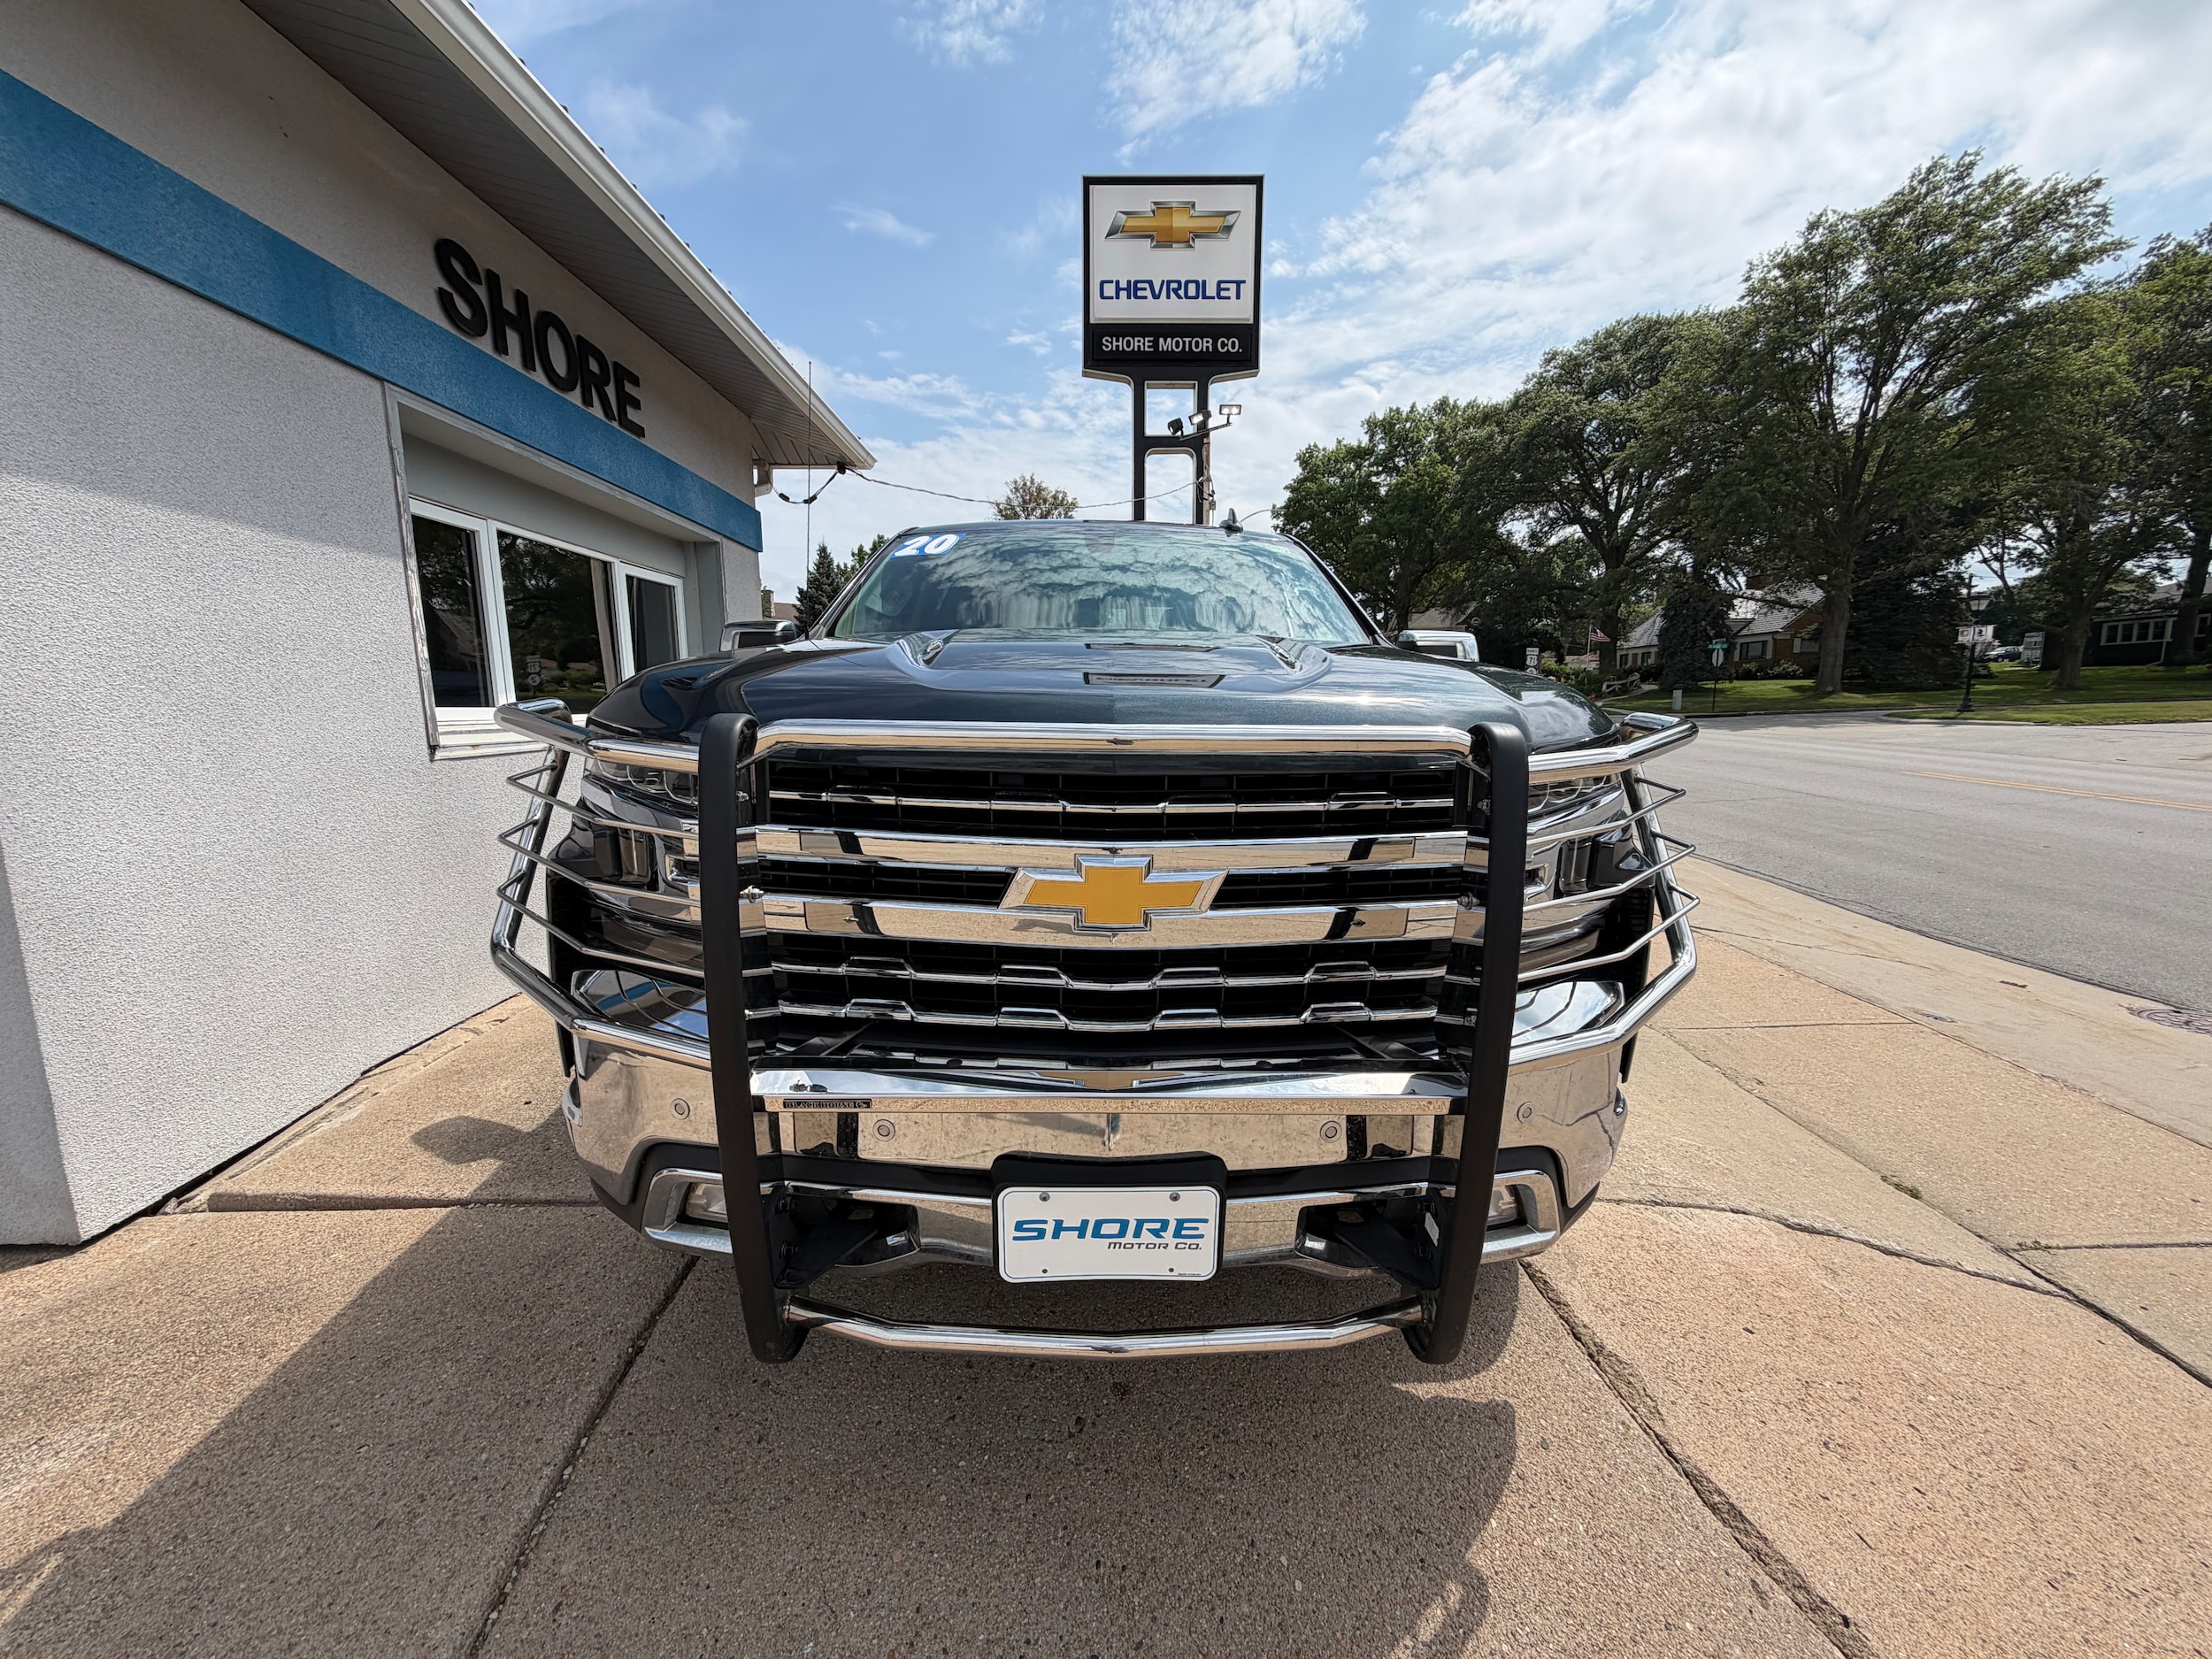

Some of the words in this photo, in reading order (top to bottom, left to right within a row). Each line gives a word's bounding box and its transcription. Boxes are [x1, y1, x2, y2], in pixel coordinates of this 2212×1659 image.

[1099, 280, 1247, 300] CHEVROLET
[434, 238, 645, 437] SHORE
[1102, 337, 1154, 351] SHORE
[1159, 337, 1213, 352] MOTOR
[1217, 337, 1243, 352] CO.
[895, 534, 959, 557] 20
[1012, 1217, 1210, 1241] SHORE
